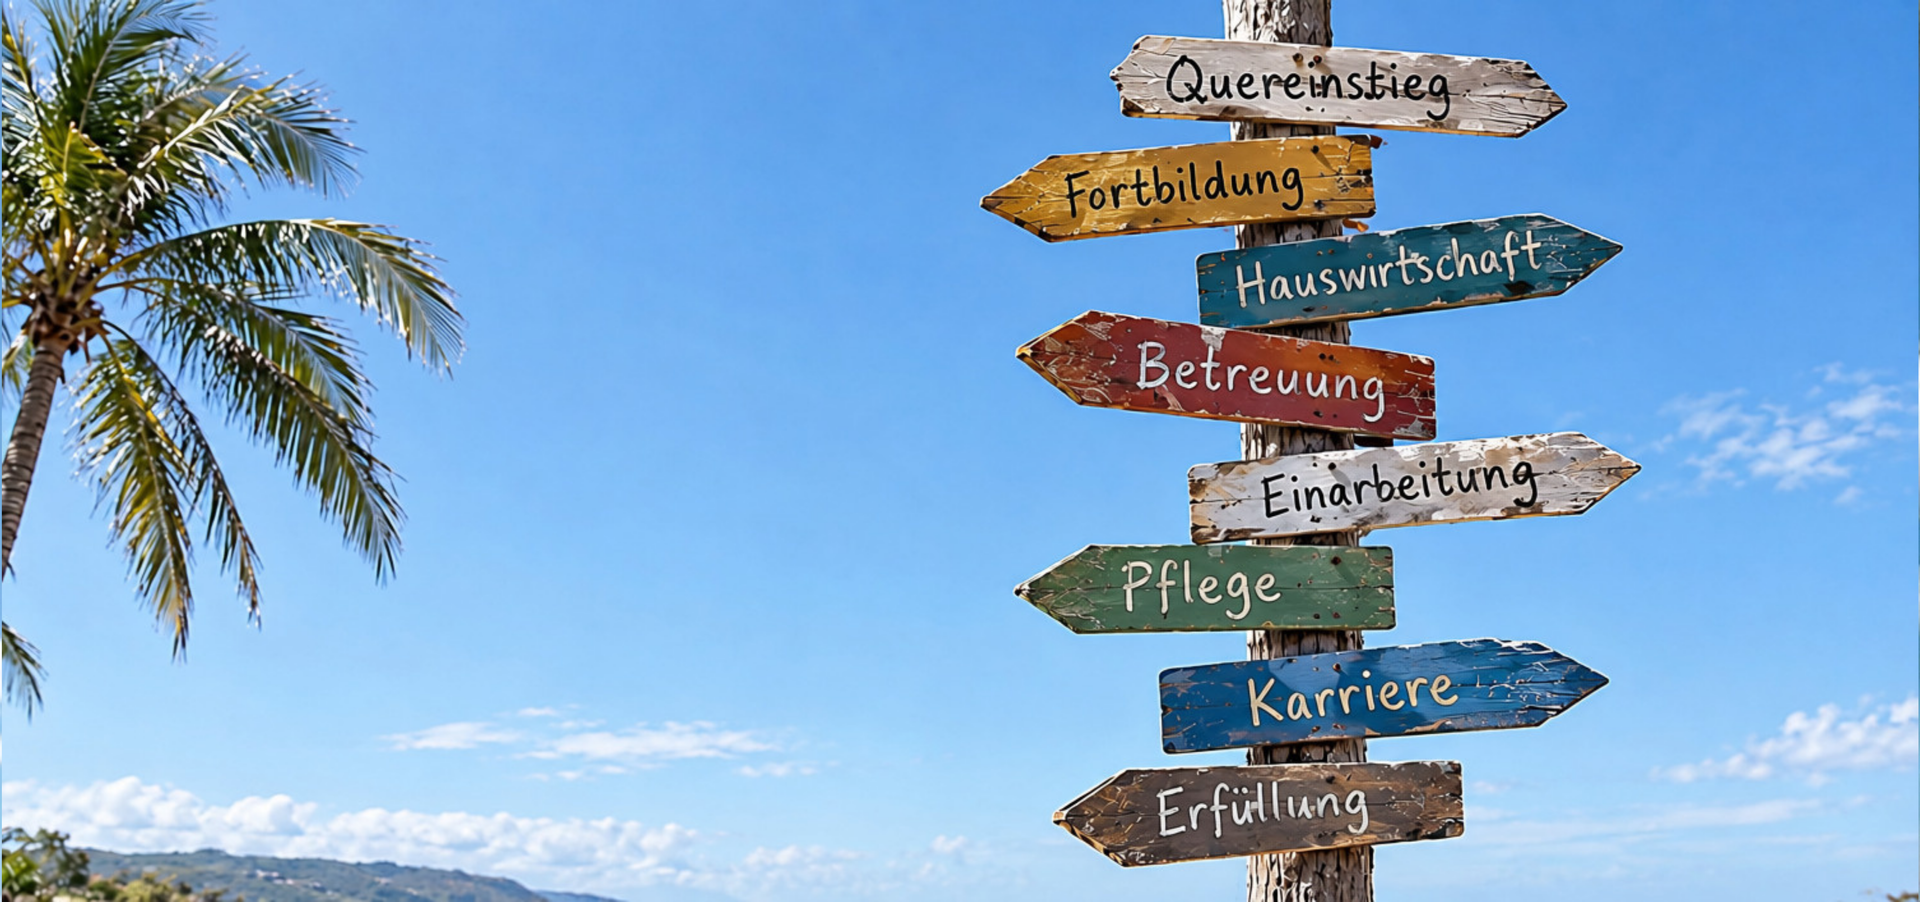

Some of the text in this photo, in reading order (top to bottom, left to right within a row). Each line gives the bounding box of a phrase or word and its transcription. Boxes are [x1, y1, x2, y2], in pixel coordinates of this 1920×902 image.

[1166, 54, 1451, 122] Quereinstieg
[1063, 160, 1304, 218] Fortbildung
[1234, 230, 1543, 308] Hauswirtschaft
[1136, 340, 1387, 422] Betreuung
[1261, 457, 1540, 519] Einarbeitung
[1121, 559, 1283, 622] Pflege
[1247, 670, 1459, 728] Karriere
[1156, 782, 1370, 839] Erfüllung
